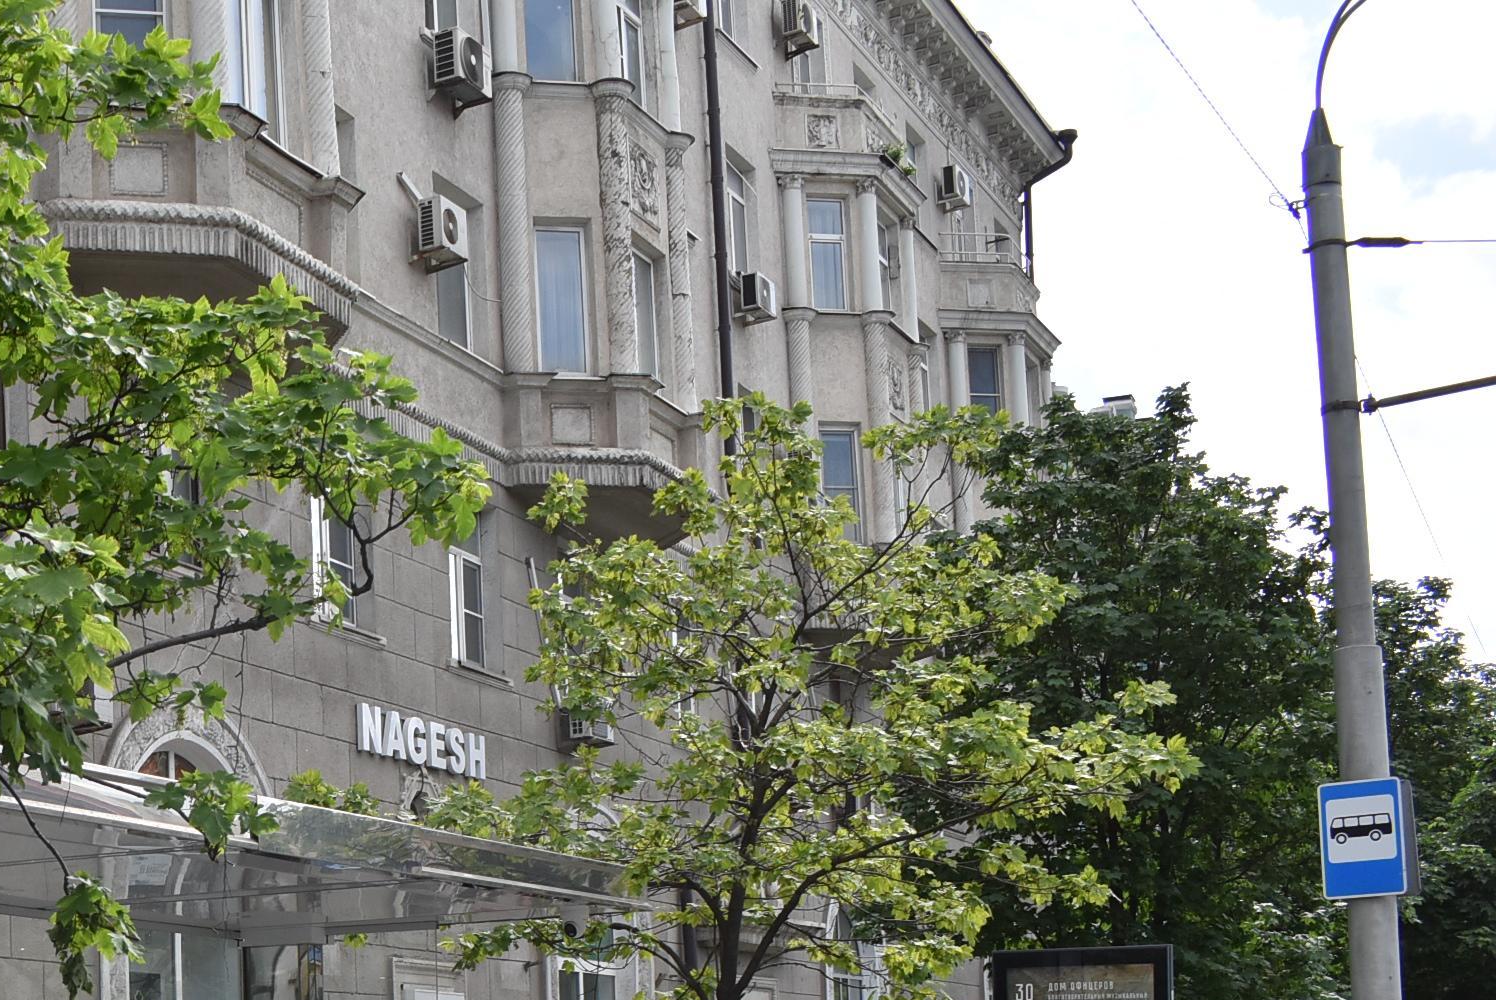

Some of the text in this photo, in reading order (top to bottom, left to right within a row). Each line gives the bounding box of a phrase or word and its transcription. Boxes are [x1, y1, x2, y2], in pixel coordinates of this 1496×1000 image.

[356, 702, 486, 780] NAGESH
[1015, 983, 1034, 1000] 30
[1048, 981, 1114, 992] ДОМ ОФИЦЕРОВ
